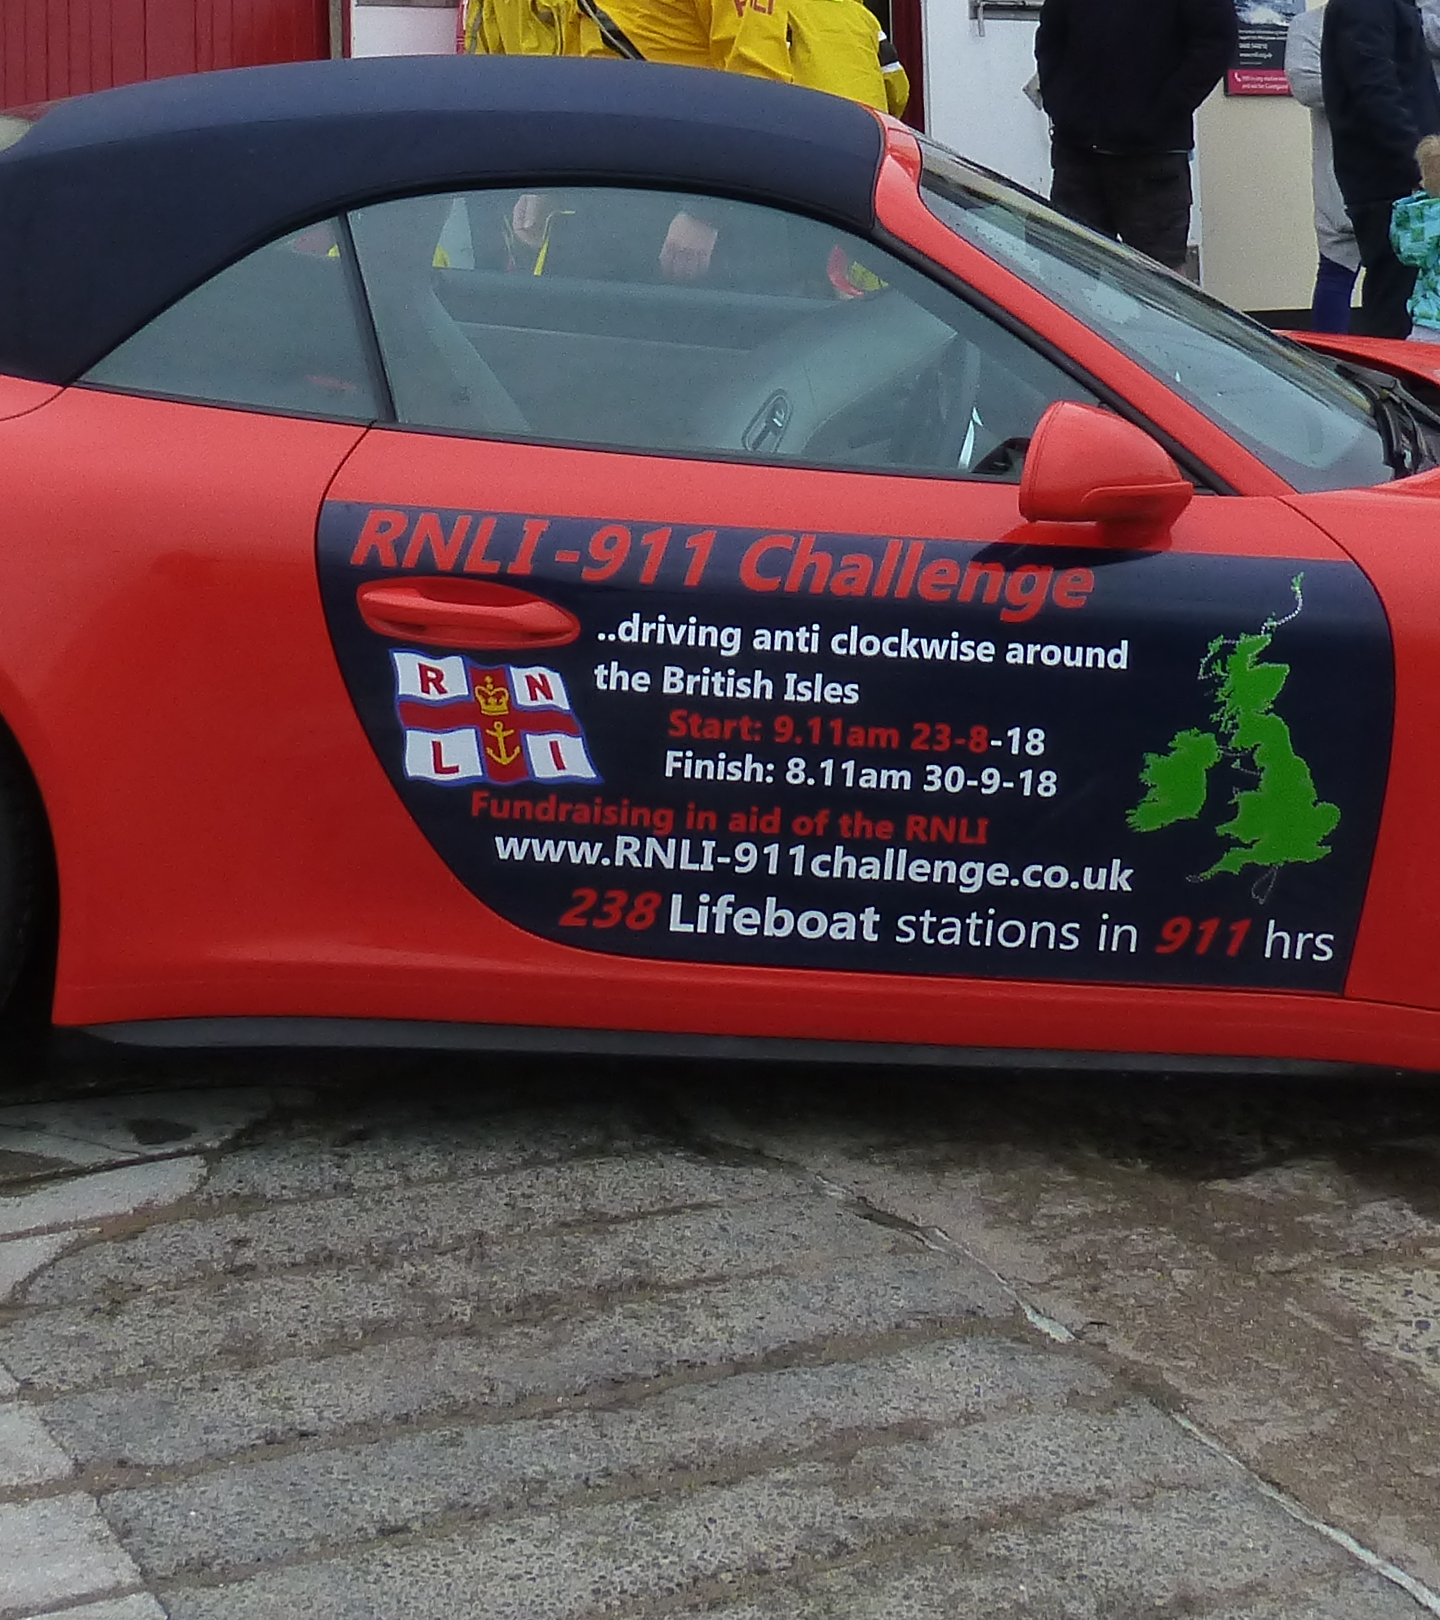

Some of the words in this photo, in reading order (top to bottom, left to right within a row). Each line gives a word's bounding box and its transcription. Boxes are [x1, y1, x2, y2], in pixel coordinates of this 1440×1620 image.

[739, 534, 1095, 623] Challenge
[752, 623, 820, 655] anti
[831, 627, 995, 664] clockwise
[1006, 640, 1129, 670] around
[417, 662, 448, 695] R
[524, 672, 554, 701] N
[594, 663, 650, 694] the
[663, 666, 774, 701] British
[783, 672, 861, 705] Isles
[668, 709, 762, 742] Start:
[774, 717, 899, 749] 9.11am
[911, 720, 1047, 756] 23-8-18
[432, 740, 460, 776] L
[549, 740, 566, 771] I
[664, 751, 775, 785] Finish:
[786, 757, 912, 792] 8.11am
[922, 764, 1058, 798] 30-9-18
[471, 790, 674, 837] Fundraising
[686, 803, 717, 831] in
[728, 805, 781, 834] aid
[792, 808, 830, 837] of
[839, 810, 895, 840] the
[905, 817, 988, 845] RNLI
[494, 834, 1134, 893] www.RNLI-911challenge.co.uk
[558, 887, 662, 931] 238
[669, 892, 880, 943] Lifeboat
[895, 907, 1080, 951] stations
[1098, 913, 1138, 954] in
[1154, 915, 1252, 957] 911
[1264, 920, 1335, 962] hrs
